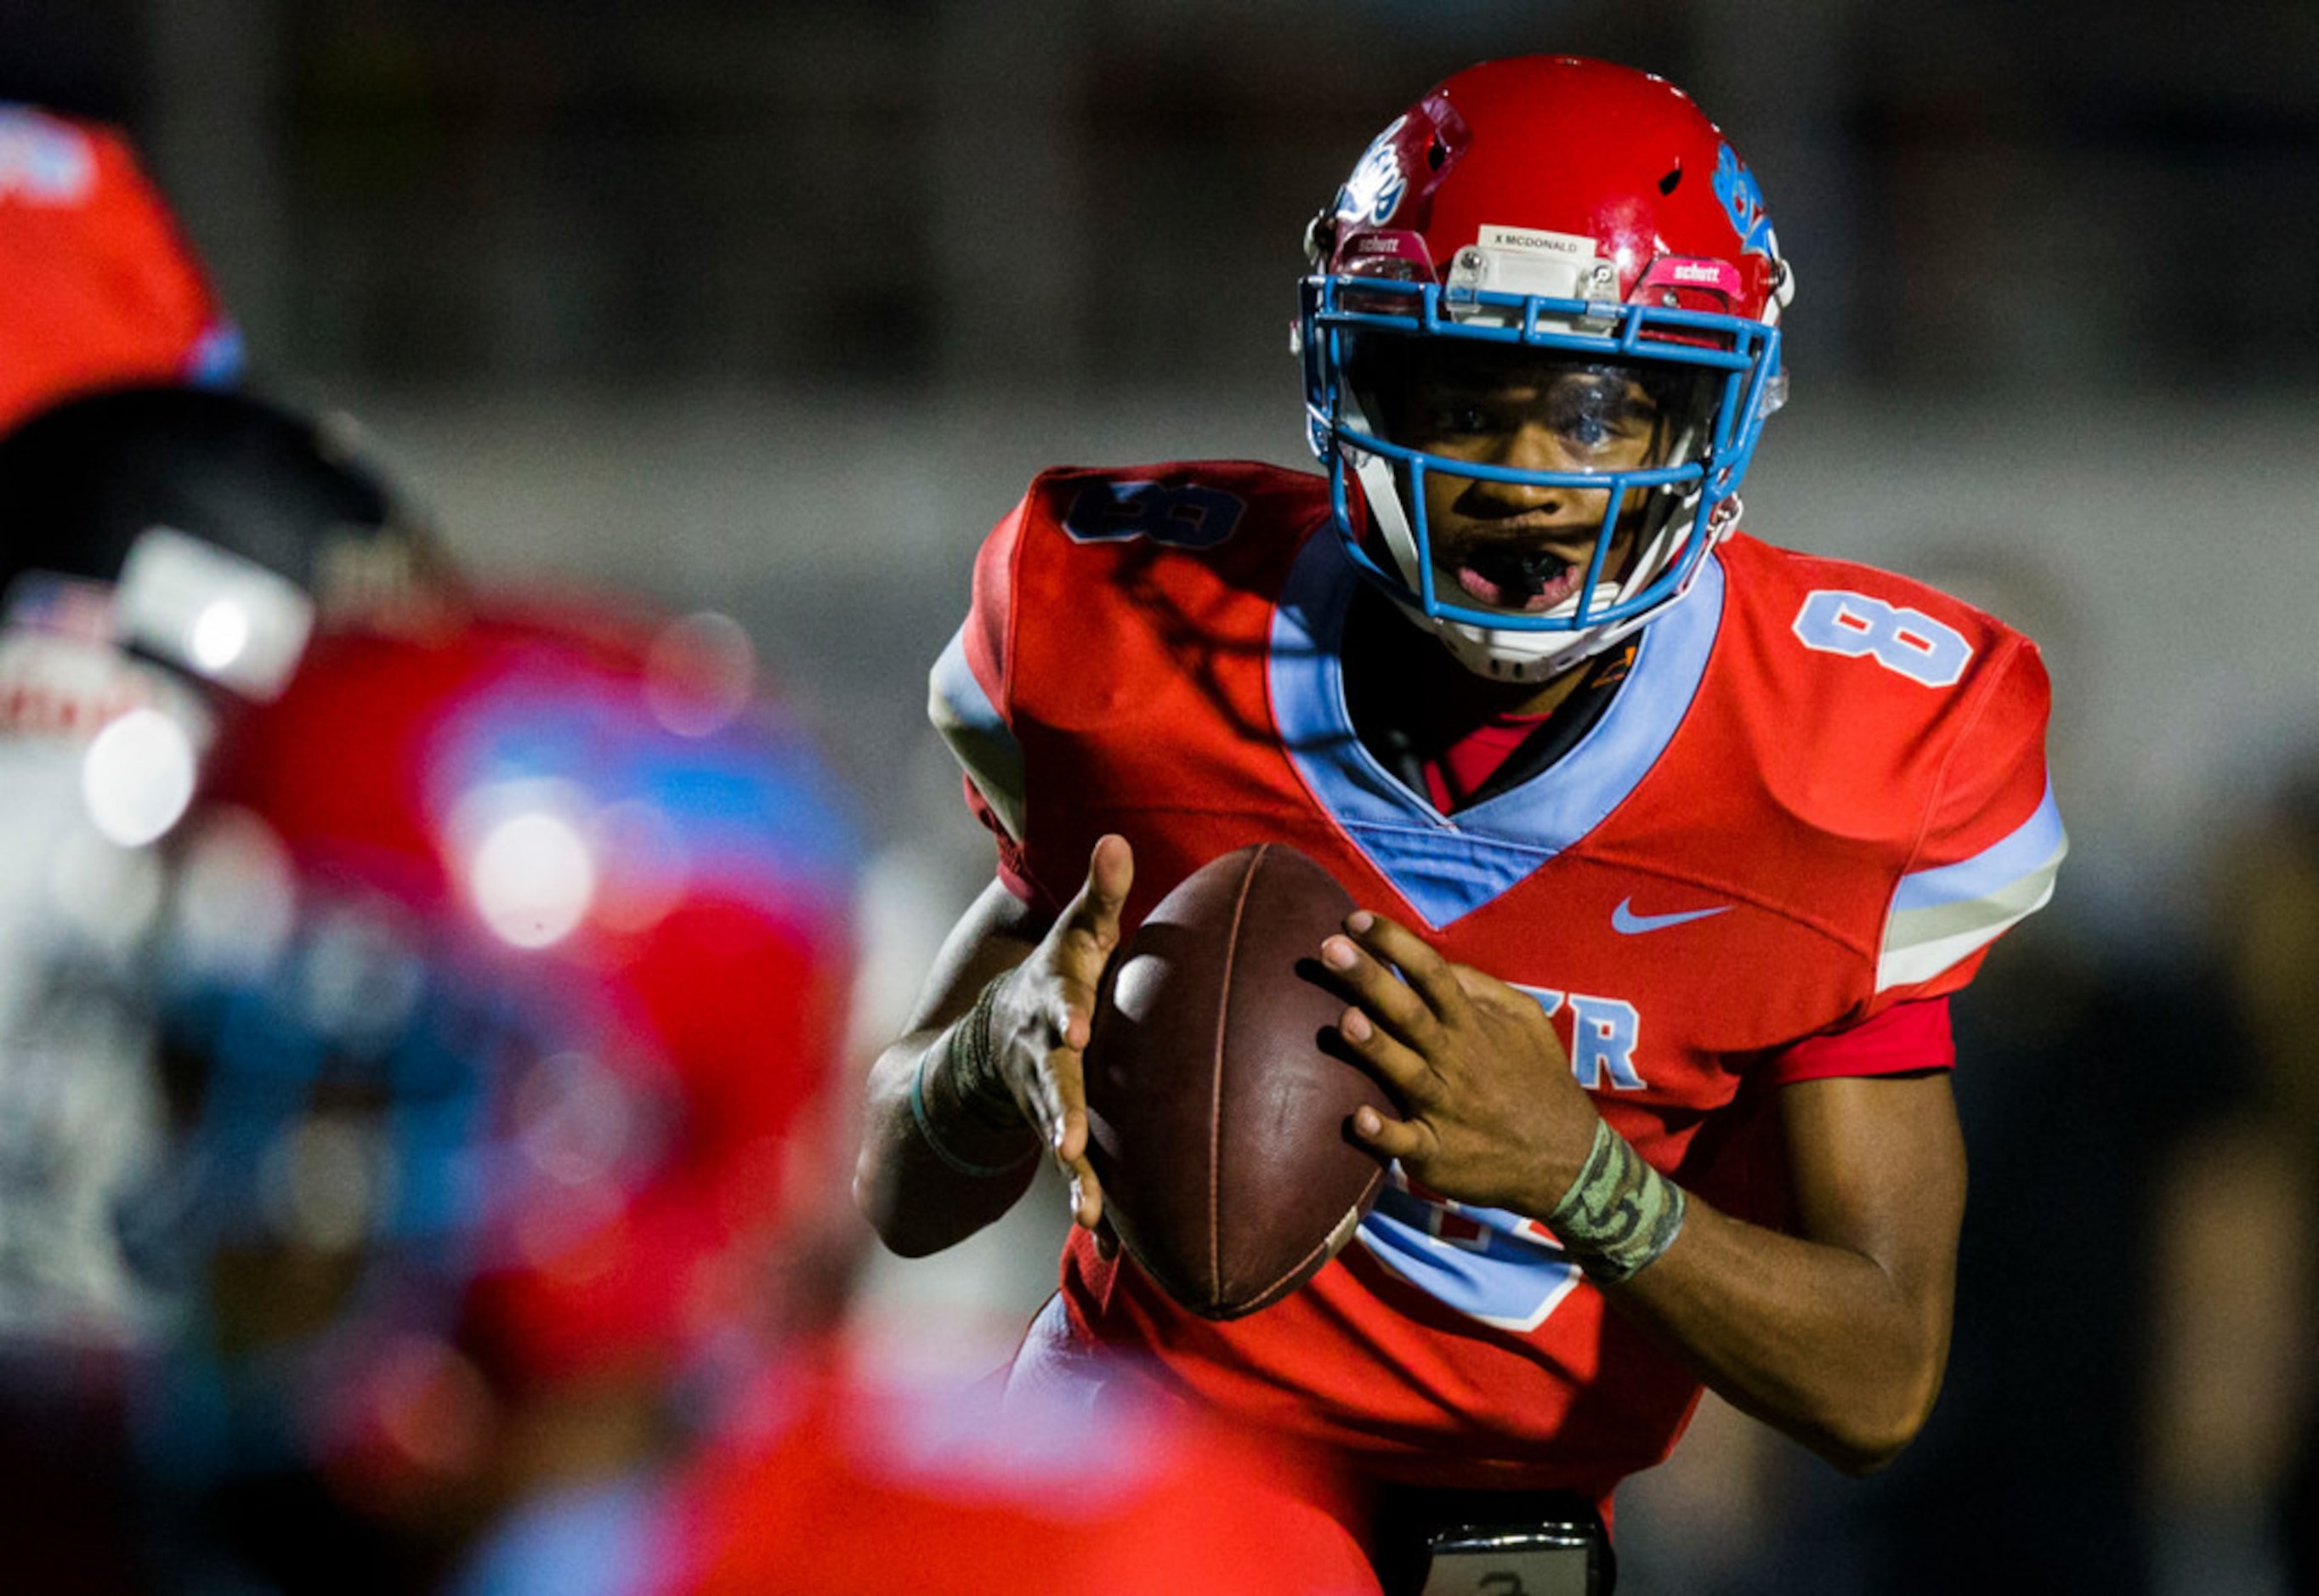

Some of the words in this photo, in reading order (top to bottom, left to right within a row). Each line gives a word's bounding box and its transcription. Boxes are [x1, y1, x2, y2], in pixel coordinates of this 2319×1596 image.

[1494, 235, 1503, 244] X
[1505, 235, 1577, 252] MCDONALD
[1674, 262, 1720, 283] schutt
[1062, 480, 1248, 549] 8
[1791, 590, 1974, 688] 8
